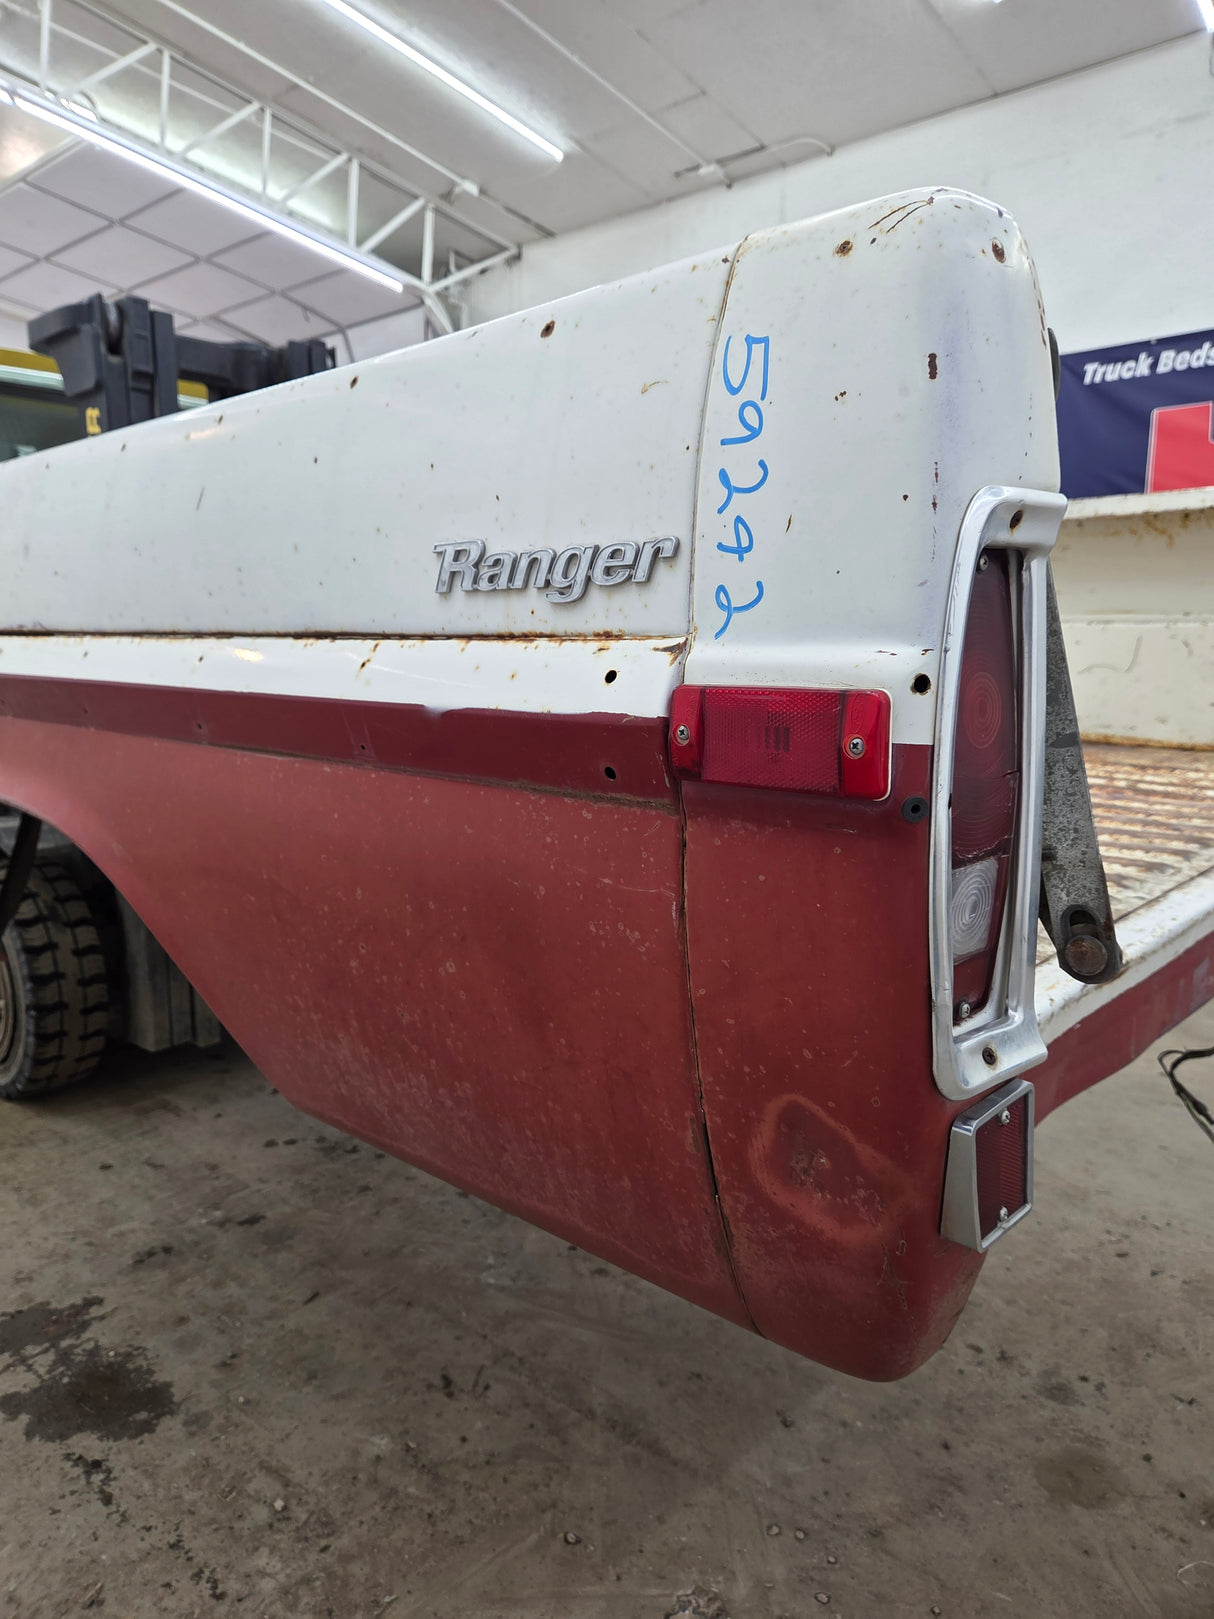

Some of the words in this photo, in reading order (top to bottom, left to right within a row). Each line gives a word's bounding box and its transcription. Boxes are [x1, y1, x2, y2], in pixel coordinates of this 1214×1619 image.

[1082, 351, 1154, 386] Truck
[1156, 340, 1214, 375] Beds
[714, 333, 770, 640] 59242
[432, 536, 681, 604] Ranger
